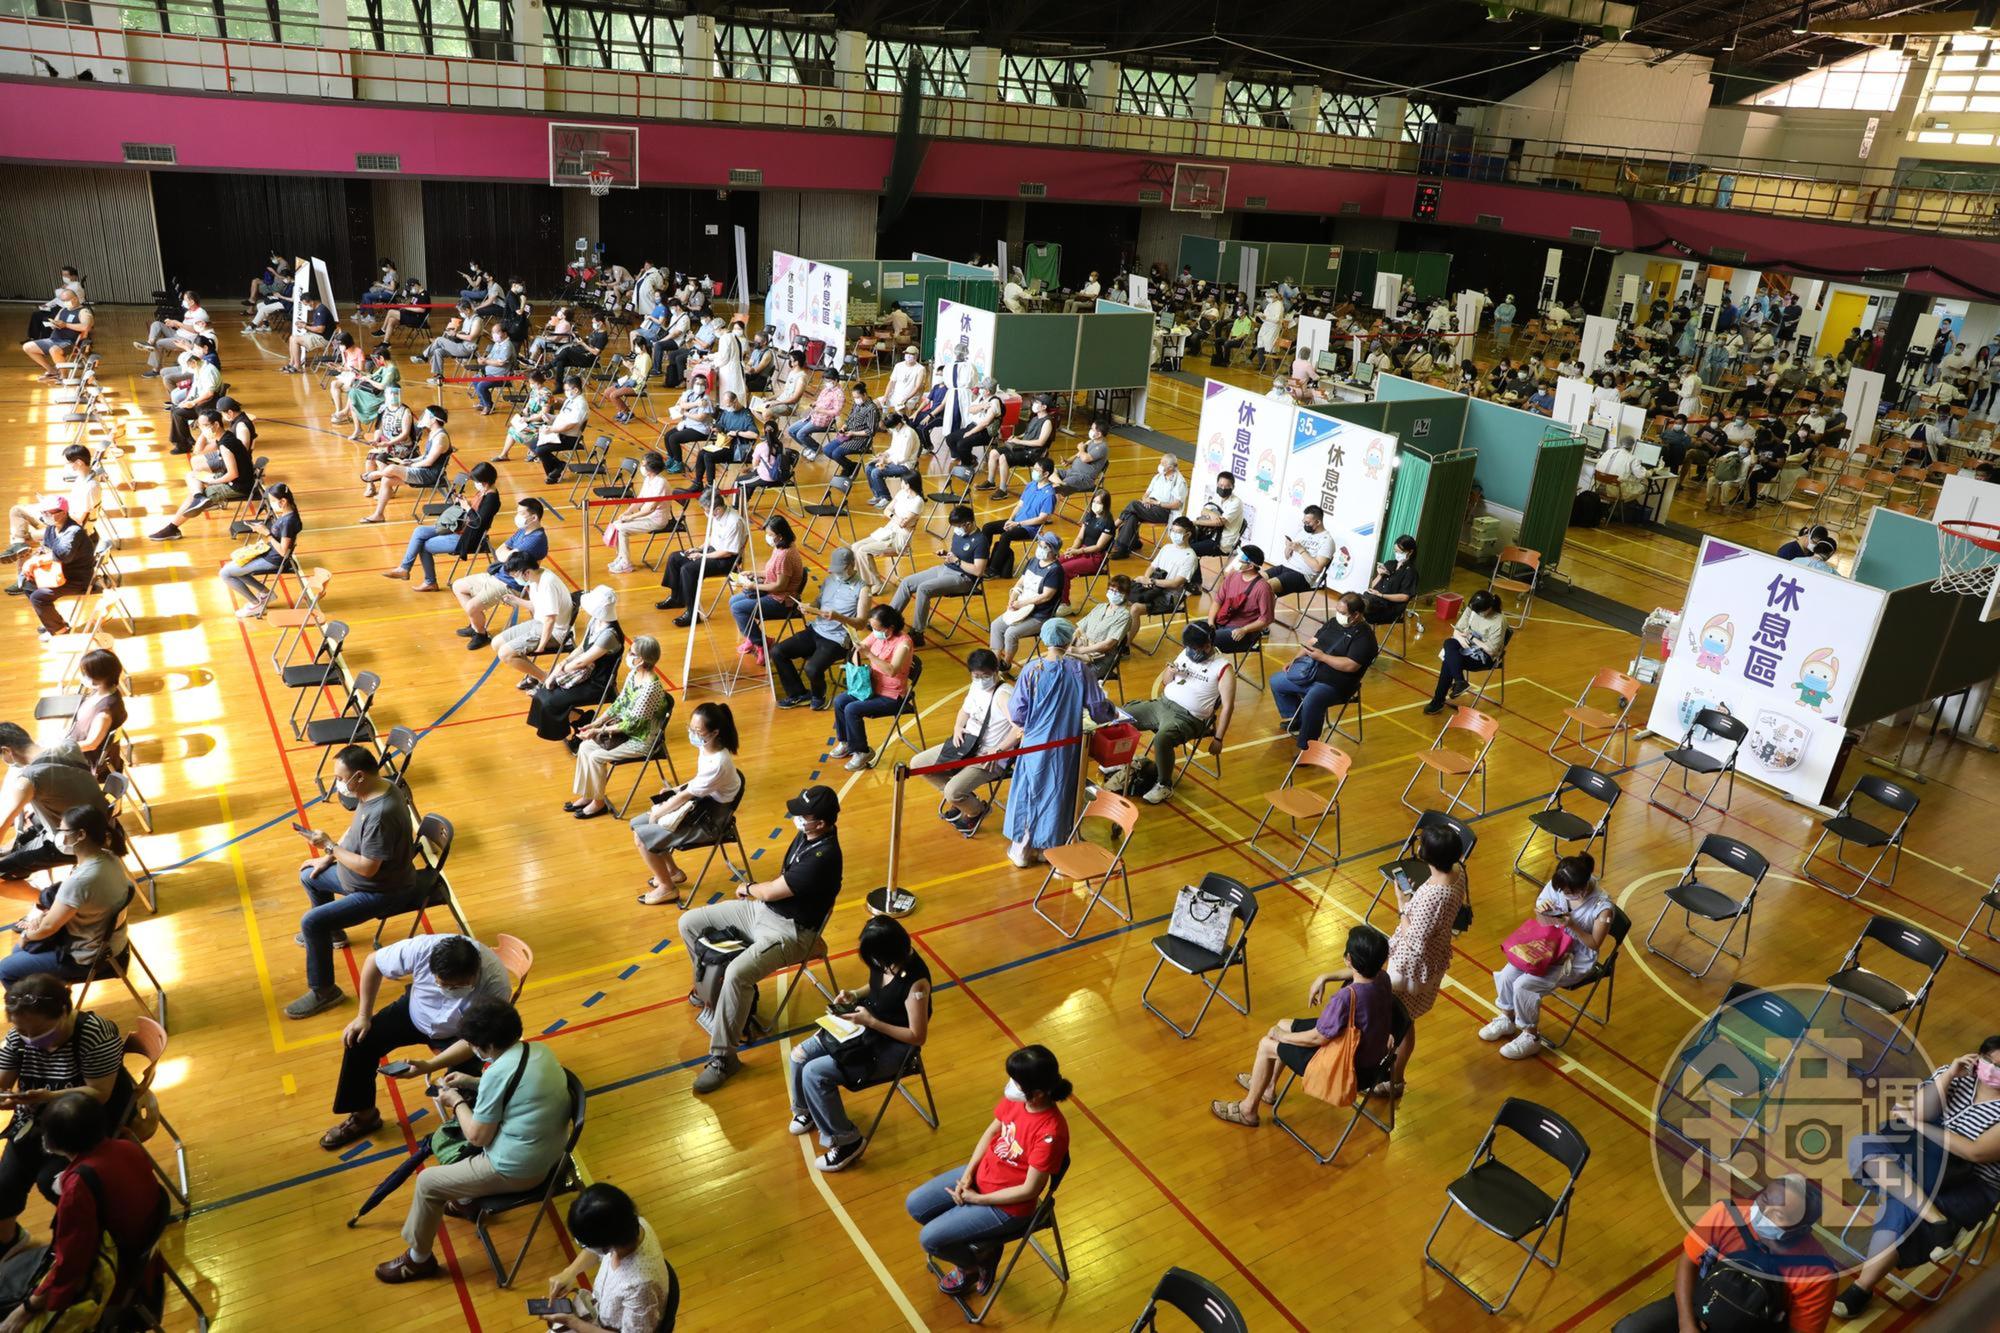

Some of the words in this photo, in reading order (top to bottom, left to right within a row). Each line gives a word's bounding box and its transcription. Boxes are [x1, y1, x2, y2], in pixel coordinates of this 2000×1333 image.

[822, 271, 832, 326] 休息區
[1231, 400, 1257, 482] 休息區
[1415, 420, 1429, 432] AZ
[1320, 443, 1346, 517] 休息區
[1743, 573, 1805, 688] 休息區
